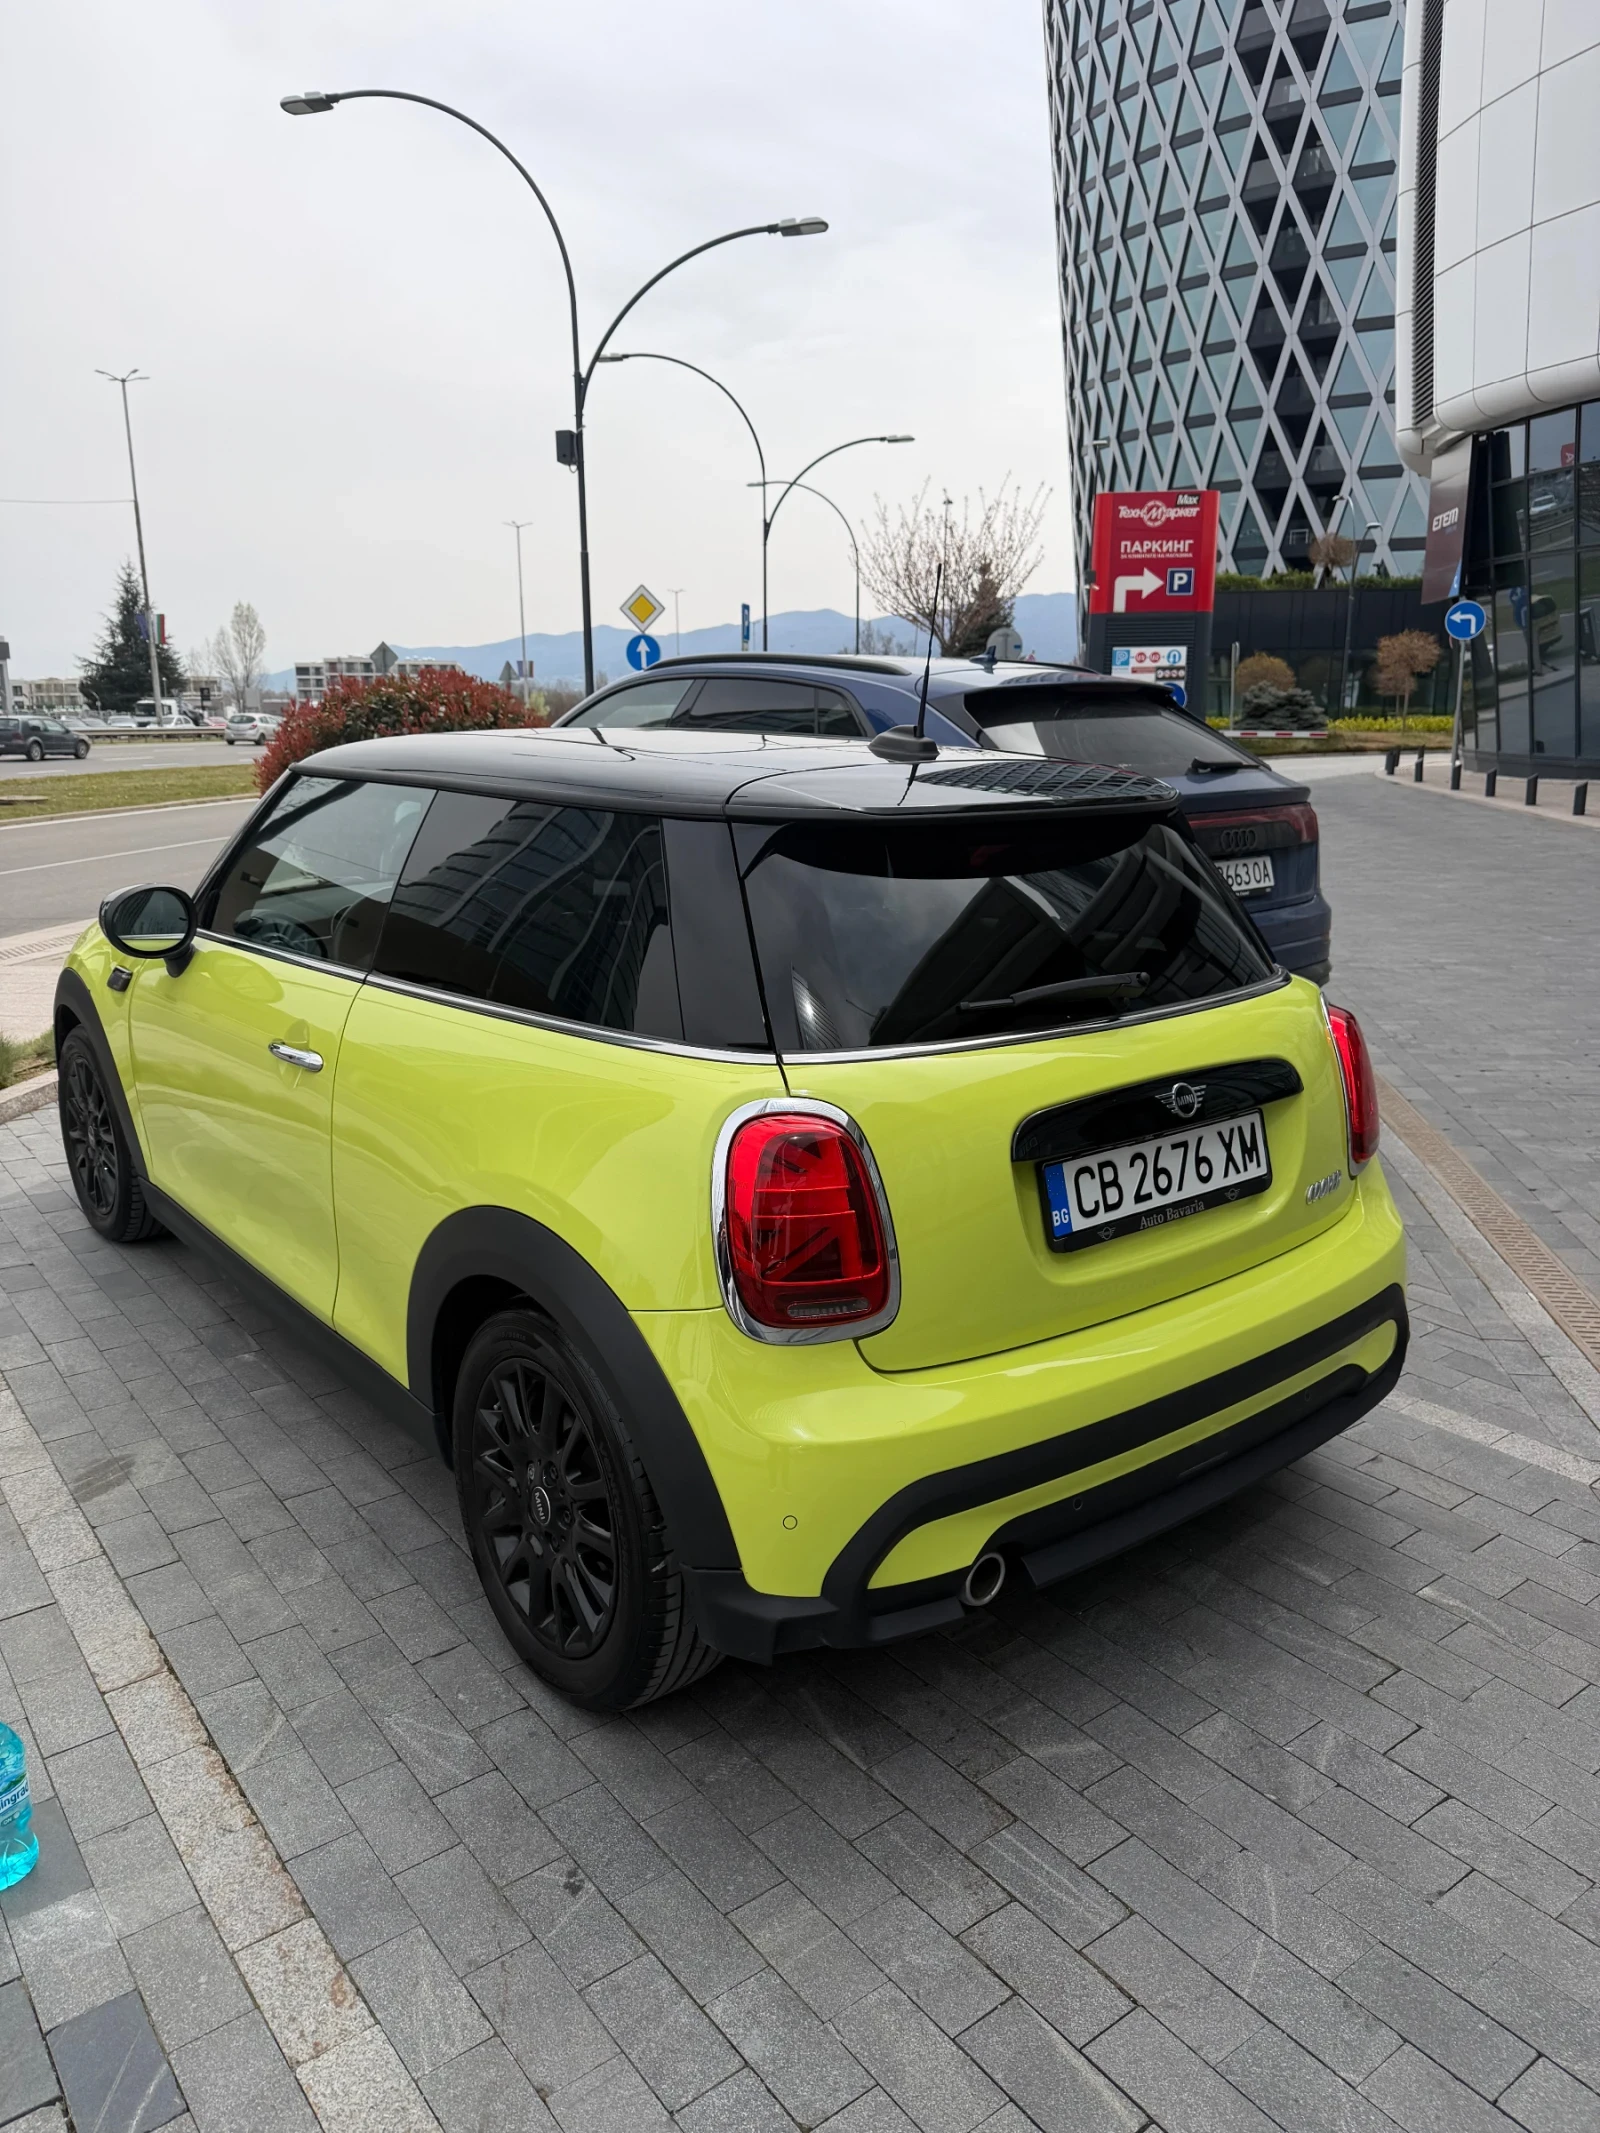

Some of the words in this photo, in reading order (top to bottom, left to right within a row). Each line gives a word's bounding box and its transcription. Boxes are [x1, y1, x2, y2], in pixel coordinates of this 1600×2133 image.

[1177, 494, 1199, 505] Max
[1120, 540, 1194, 553] ПАРКИНГ
[1173, 573, 1188, 591] P
[1073, 1160, 1124, 1219] CB
[1129, 1135, 1213, 1205] 2676
[1217, 1121, 1261, 1179] XM
[1052, 1208, 1070, 1227] BG
[1140, 1214, 1164, 1230] Auto
[1166, 1200, 1205, 1221] Bavaria
[535, 1492, 545, 1519] MINI
